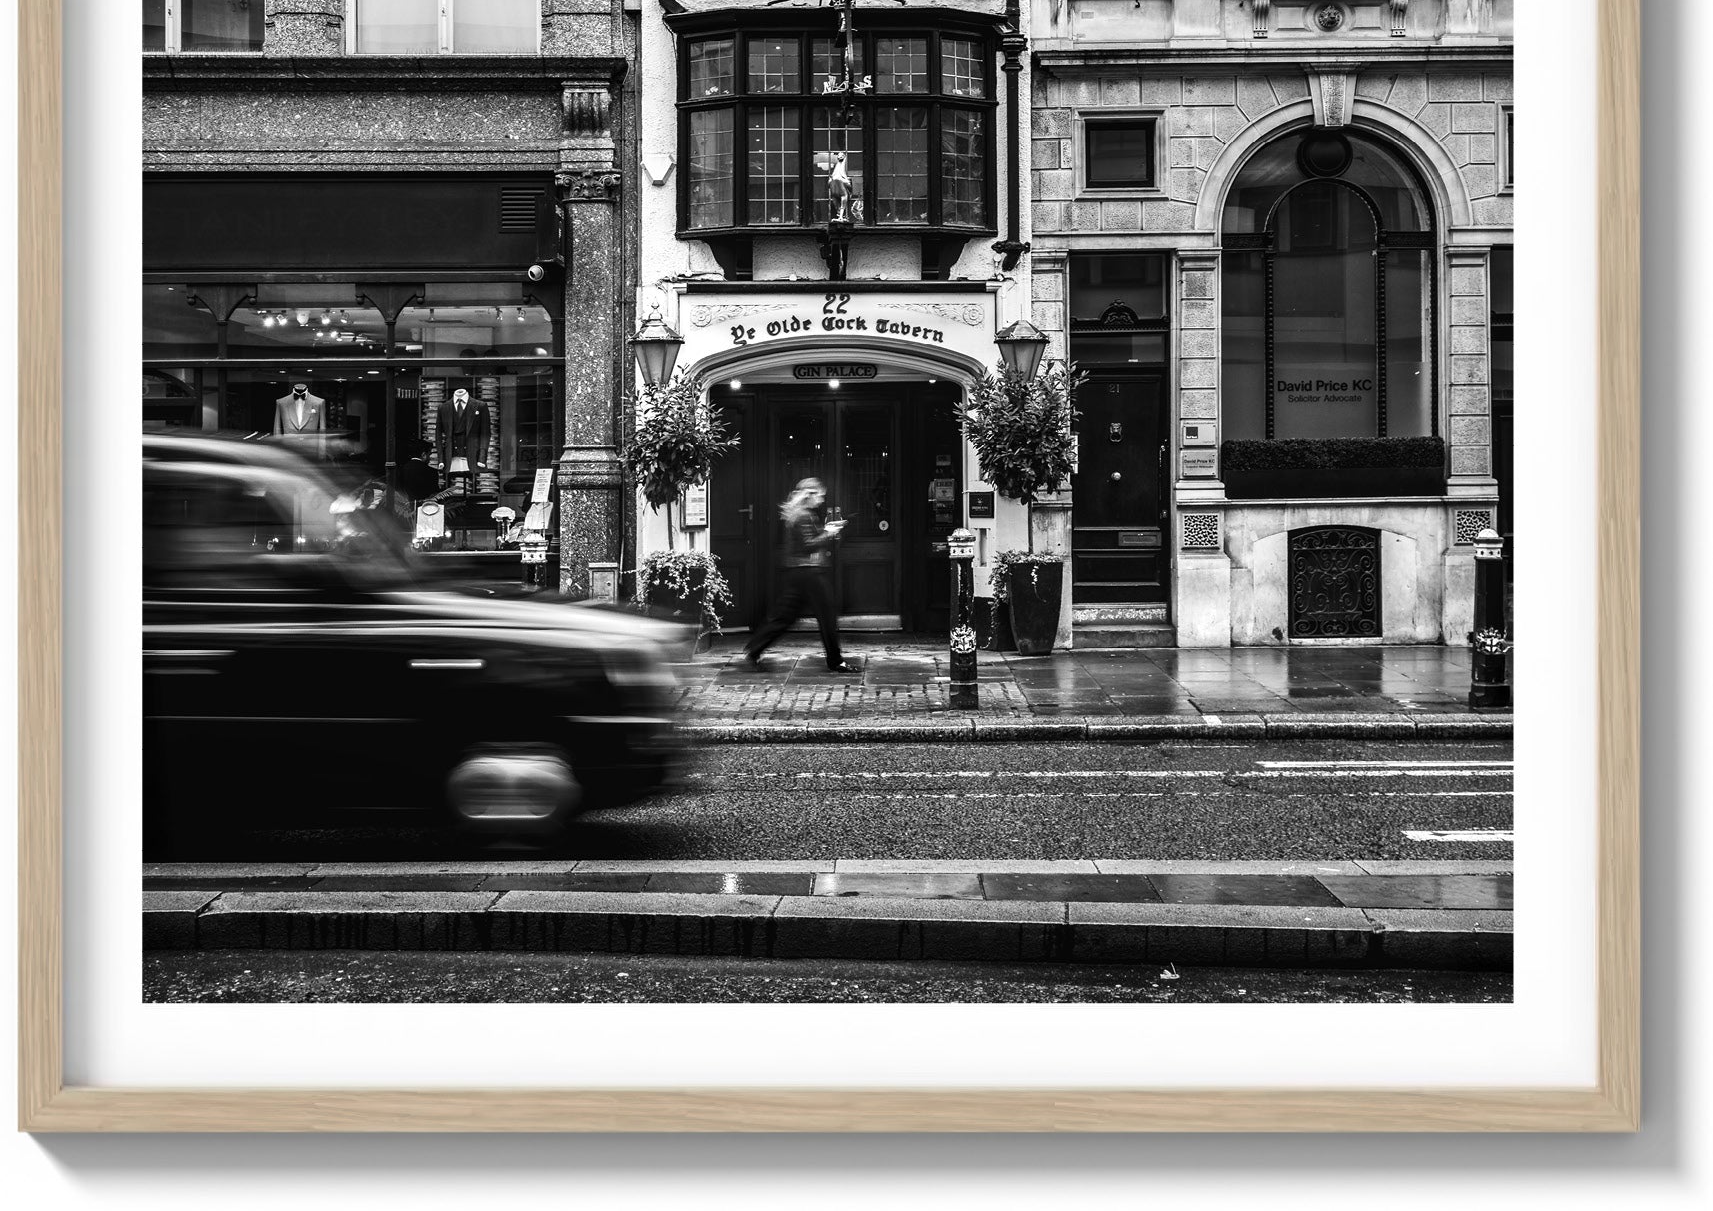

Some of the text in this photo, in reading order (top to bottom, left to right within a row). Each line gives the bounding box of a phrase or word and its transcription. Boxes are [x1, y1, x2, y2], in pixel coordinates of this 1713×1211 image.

[822, 292, 851, 315] 22
[730, 315, 944, 347] Ye Olde Cock Tavern
[799, 367, 873, 378] GIN PALACE
[1108, 383, 1120, 394] 21
[1277, 379, 1373, 392] David Price KC
[1287, 394, 1362, 403] Solicitor Advocate
